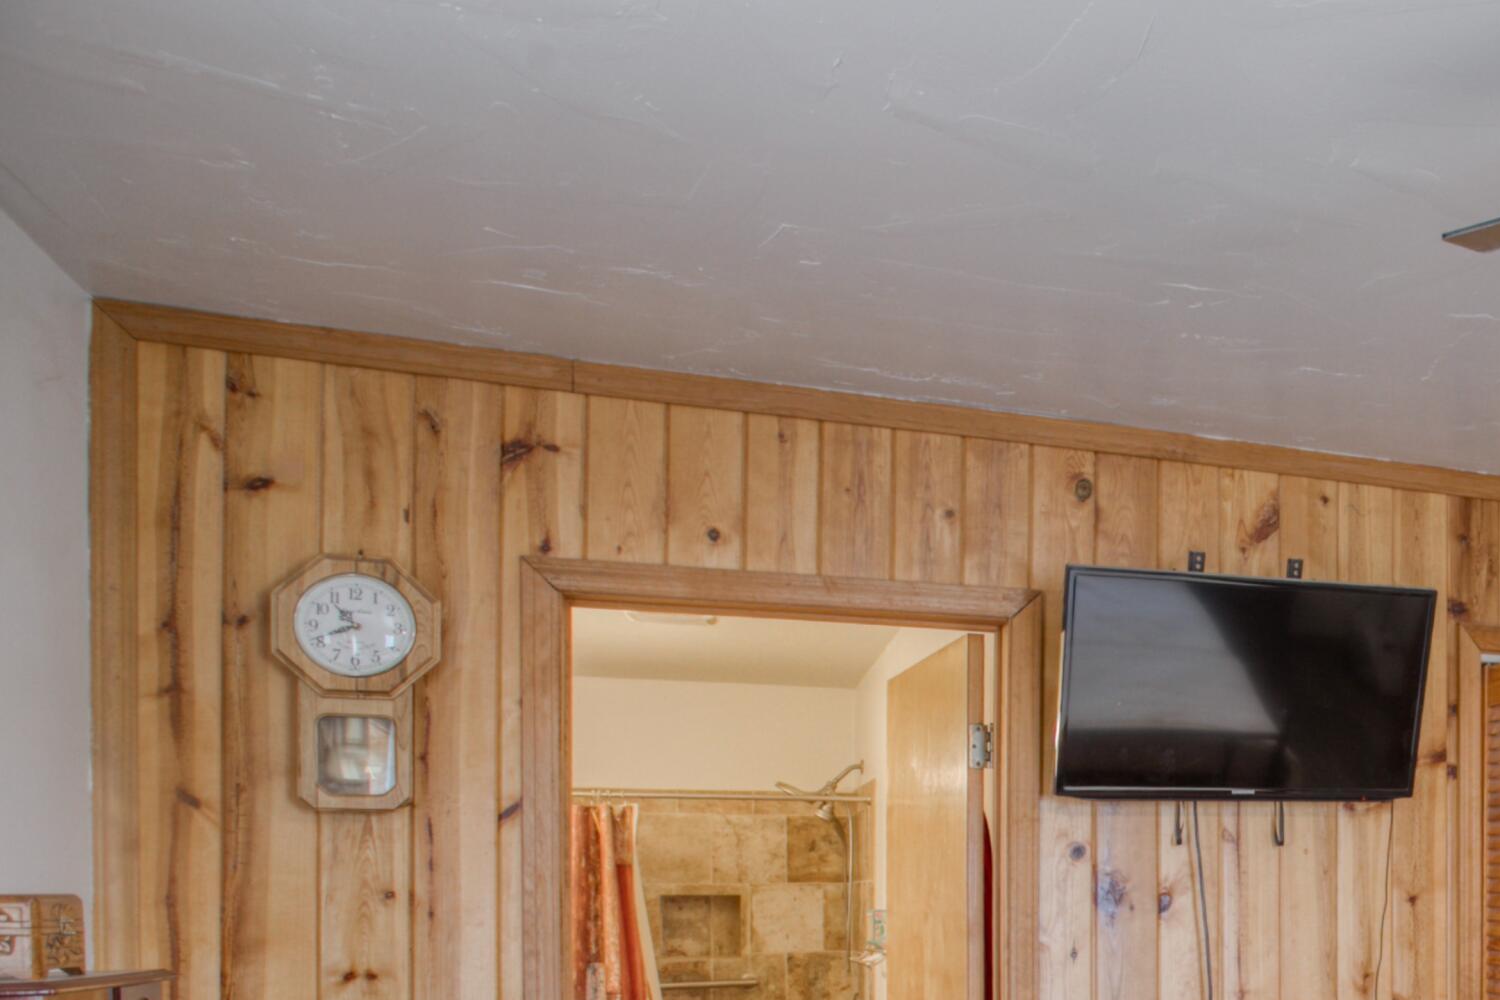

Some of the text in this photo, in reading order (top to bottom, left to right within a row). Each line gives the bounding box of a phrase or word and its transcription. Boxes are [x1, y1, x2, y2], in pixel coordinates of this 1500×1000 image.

[329, 590, 340, 604] 11
[348, 587, 363, 601] 12
[373, 592, 378, 605] 1
[316, 603, 330, 615] 10
[386, 604, 396, 617] 2
[308, 618, 319, 631] 9
[393, 623, 403, 635] 3
[315, 634, 326, 648] 8
[332, 648, 341, 661] 7
[371, 649, 381, 663] 5
